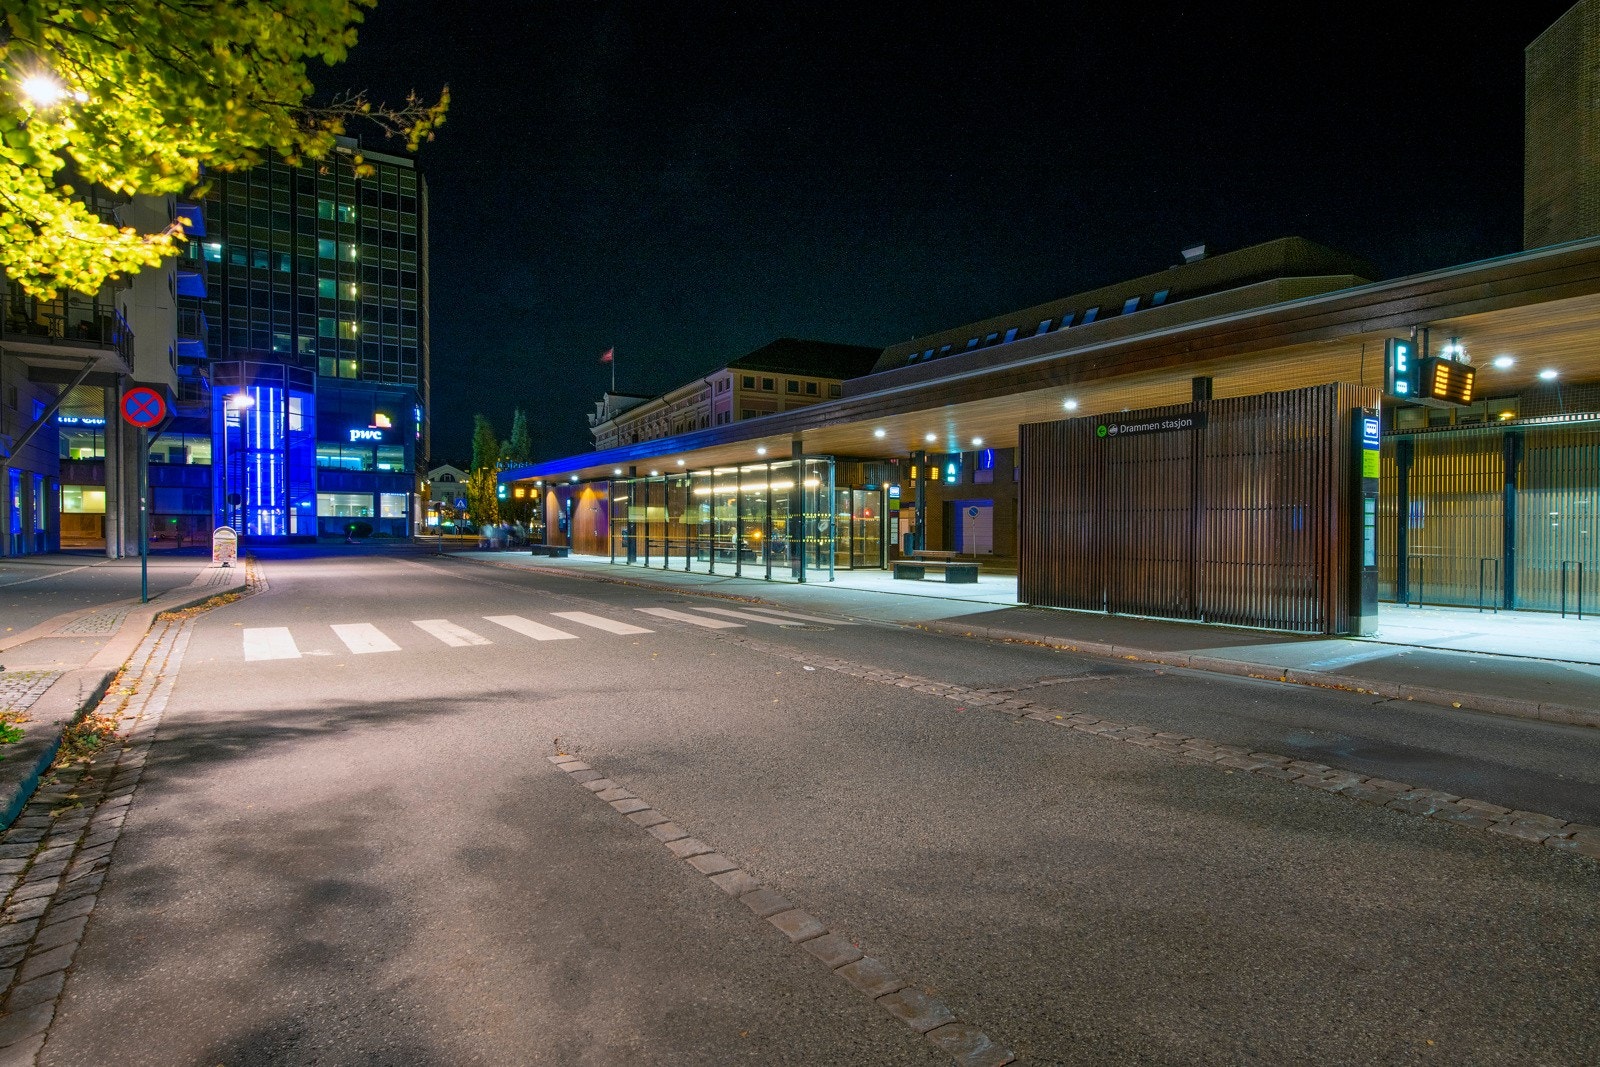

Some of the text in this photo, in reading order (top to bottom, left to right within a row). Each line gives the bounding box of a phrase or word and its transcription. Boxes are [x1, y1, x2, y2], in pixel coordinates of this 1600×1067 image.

[1398, 346, 1406, 371] E
[1120, 419, 1192, 433] Drammen stasjon
[350, 429, 382, 441] pwc
[948, 464, 955, 474] A
